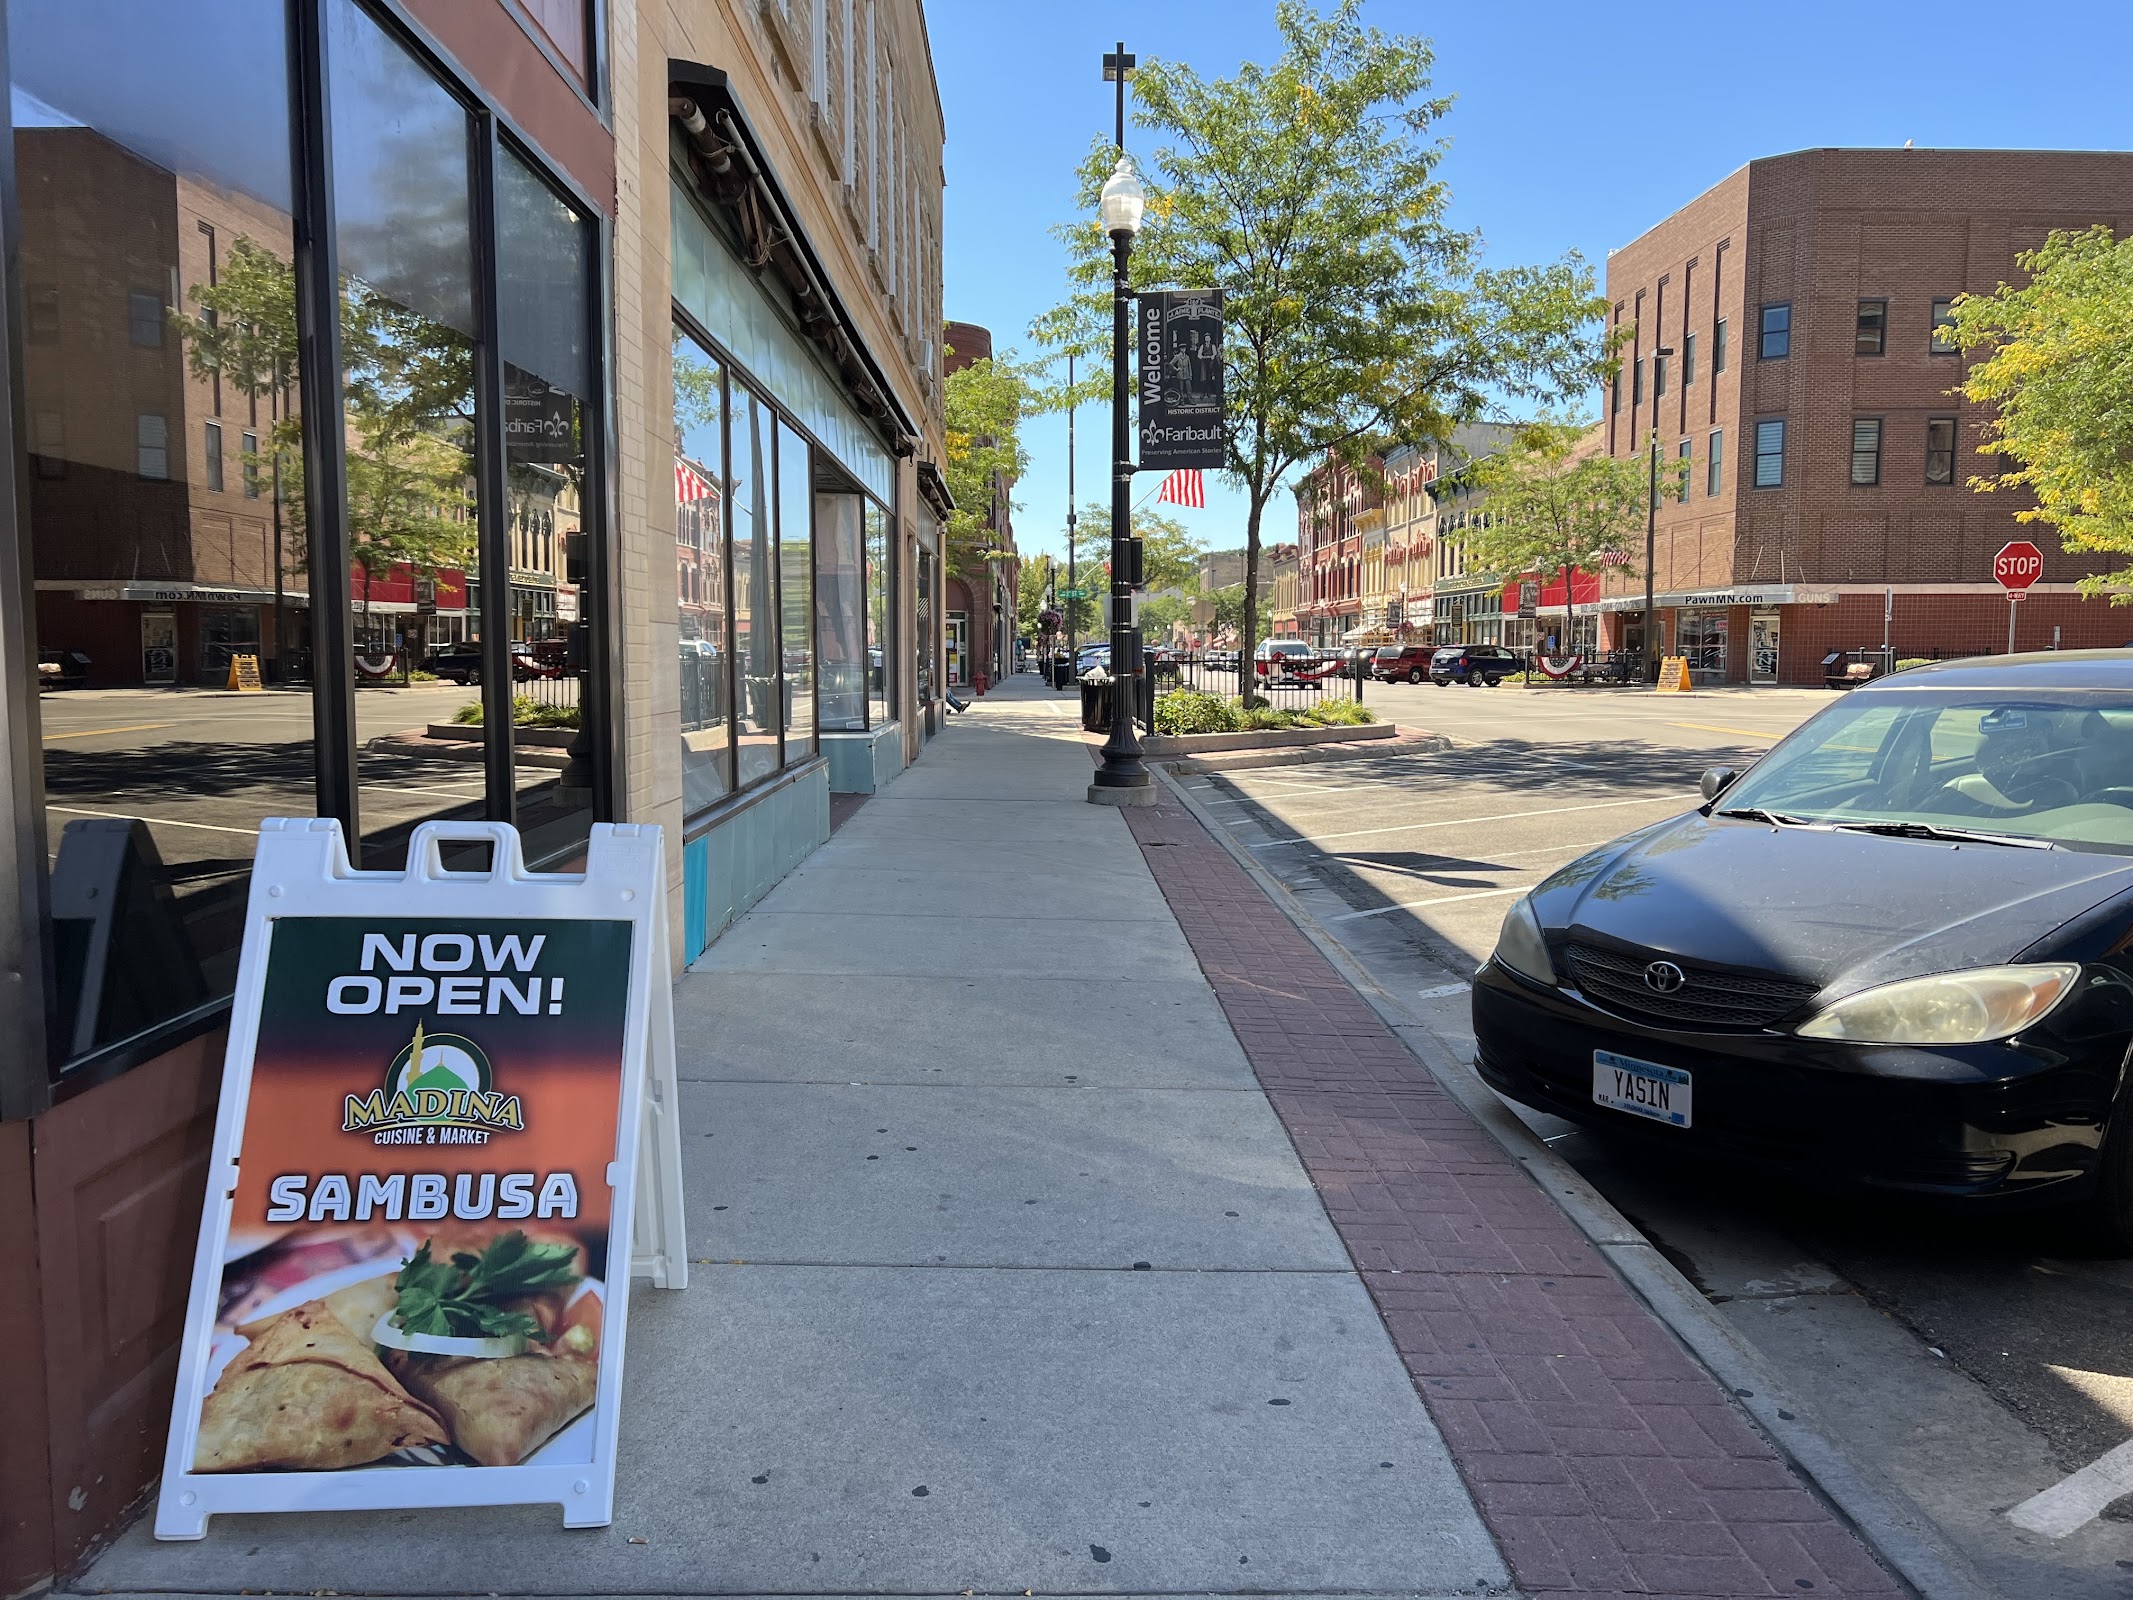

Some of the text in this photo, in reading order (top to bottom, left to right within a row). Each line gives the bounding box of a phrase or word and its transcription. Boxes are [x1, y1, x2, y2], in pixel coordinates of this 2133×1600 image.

[1143, 308, 1161, 405] Welcome
[1165, 425, 1222, 441] Faribault
[1997, 557, 2039, 575] STOP
[1685, 594, 1763, 605] PawnMN.com
[1798, 593, 1830, 604] GUNS
[360, 933, 546, 972] NOW
[326, 975, 565, 1015] OPEN!
[1619, 1058, 1664, 1078] Minnesota
[1614, 1069, 1669, 1110] YASIN
[342, 1088, 524, 1131] MADINA
[374, 1126, 490, 1145] CUISINE & MARKET
[267, 1173, 578, 1222] SAMBUSA
